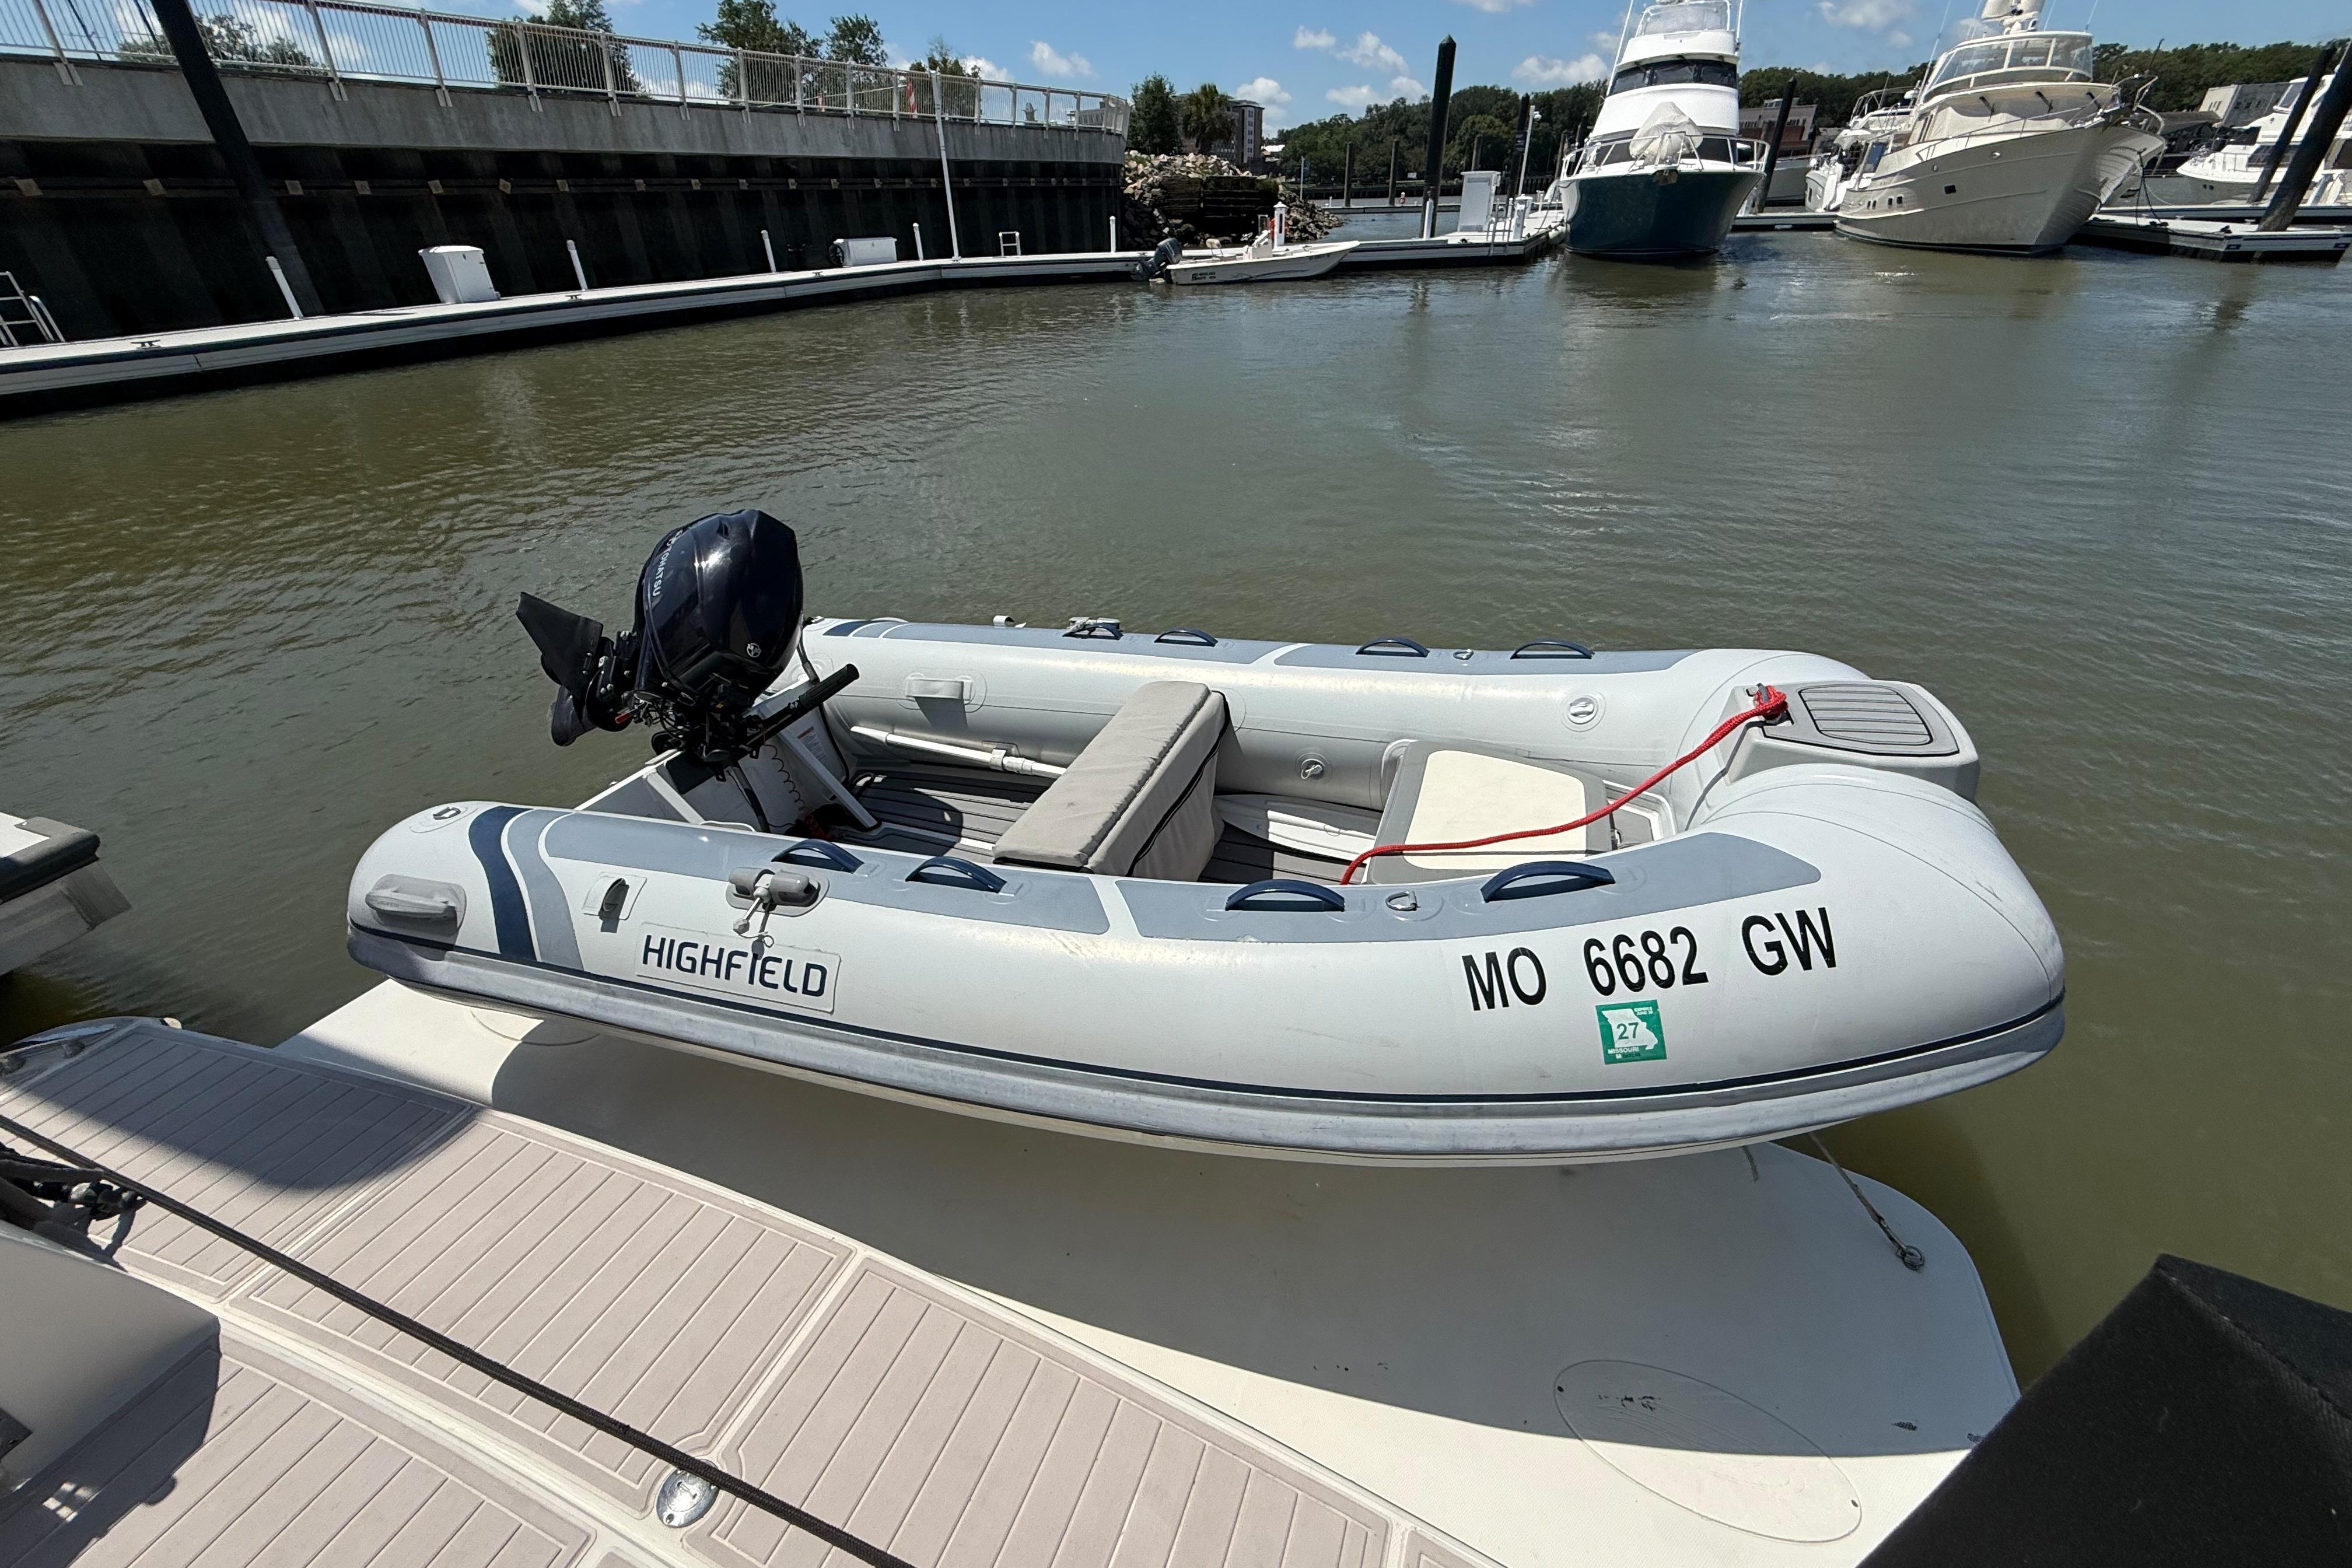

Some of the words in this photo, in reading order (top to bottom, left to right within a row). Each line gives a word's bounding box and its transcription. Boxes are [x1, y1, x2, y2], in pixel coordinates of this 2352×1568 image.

[653, 545, 672, 596] TOHATSU
[642, 935, 827, 997] HIGHFIELD
[1462, 947, 1546, 1011] MO
[1583, 926, 1709, 996] 6682
[1741, 907, 1836, 976] GW
[1608, 1046, 1639, 1055] MISSOURI
[1616, 1022, 1639, 1040] 27
